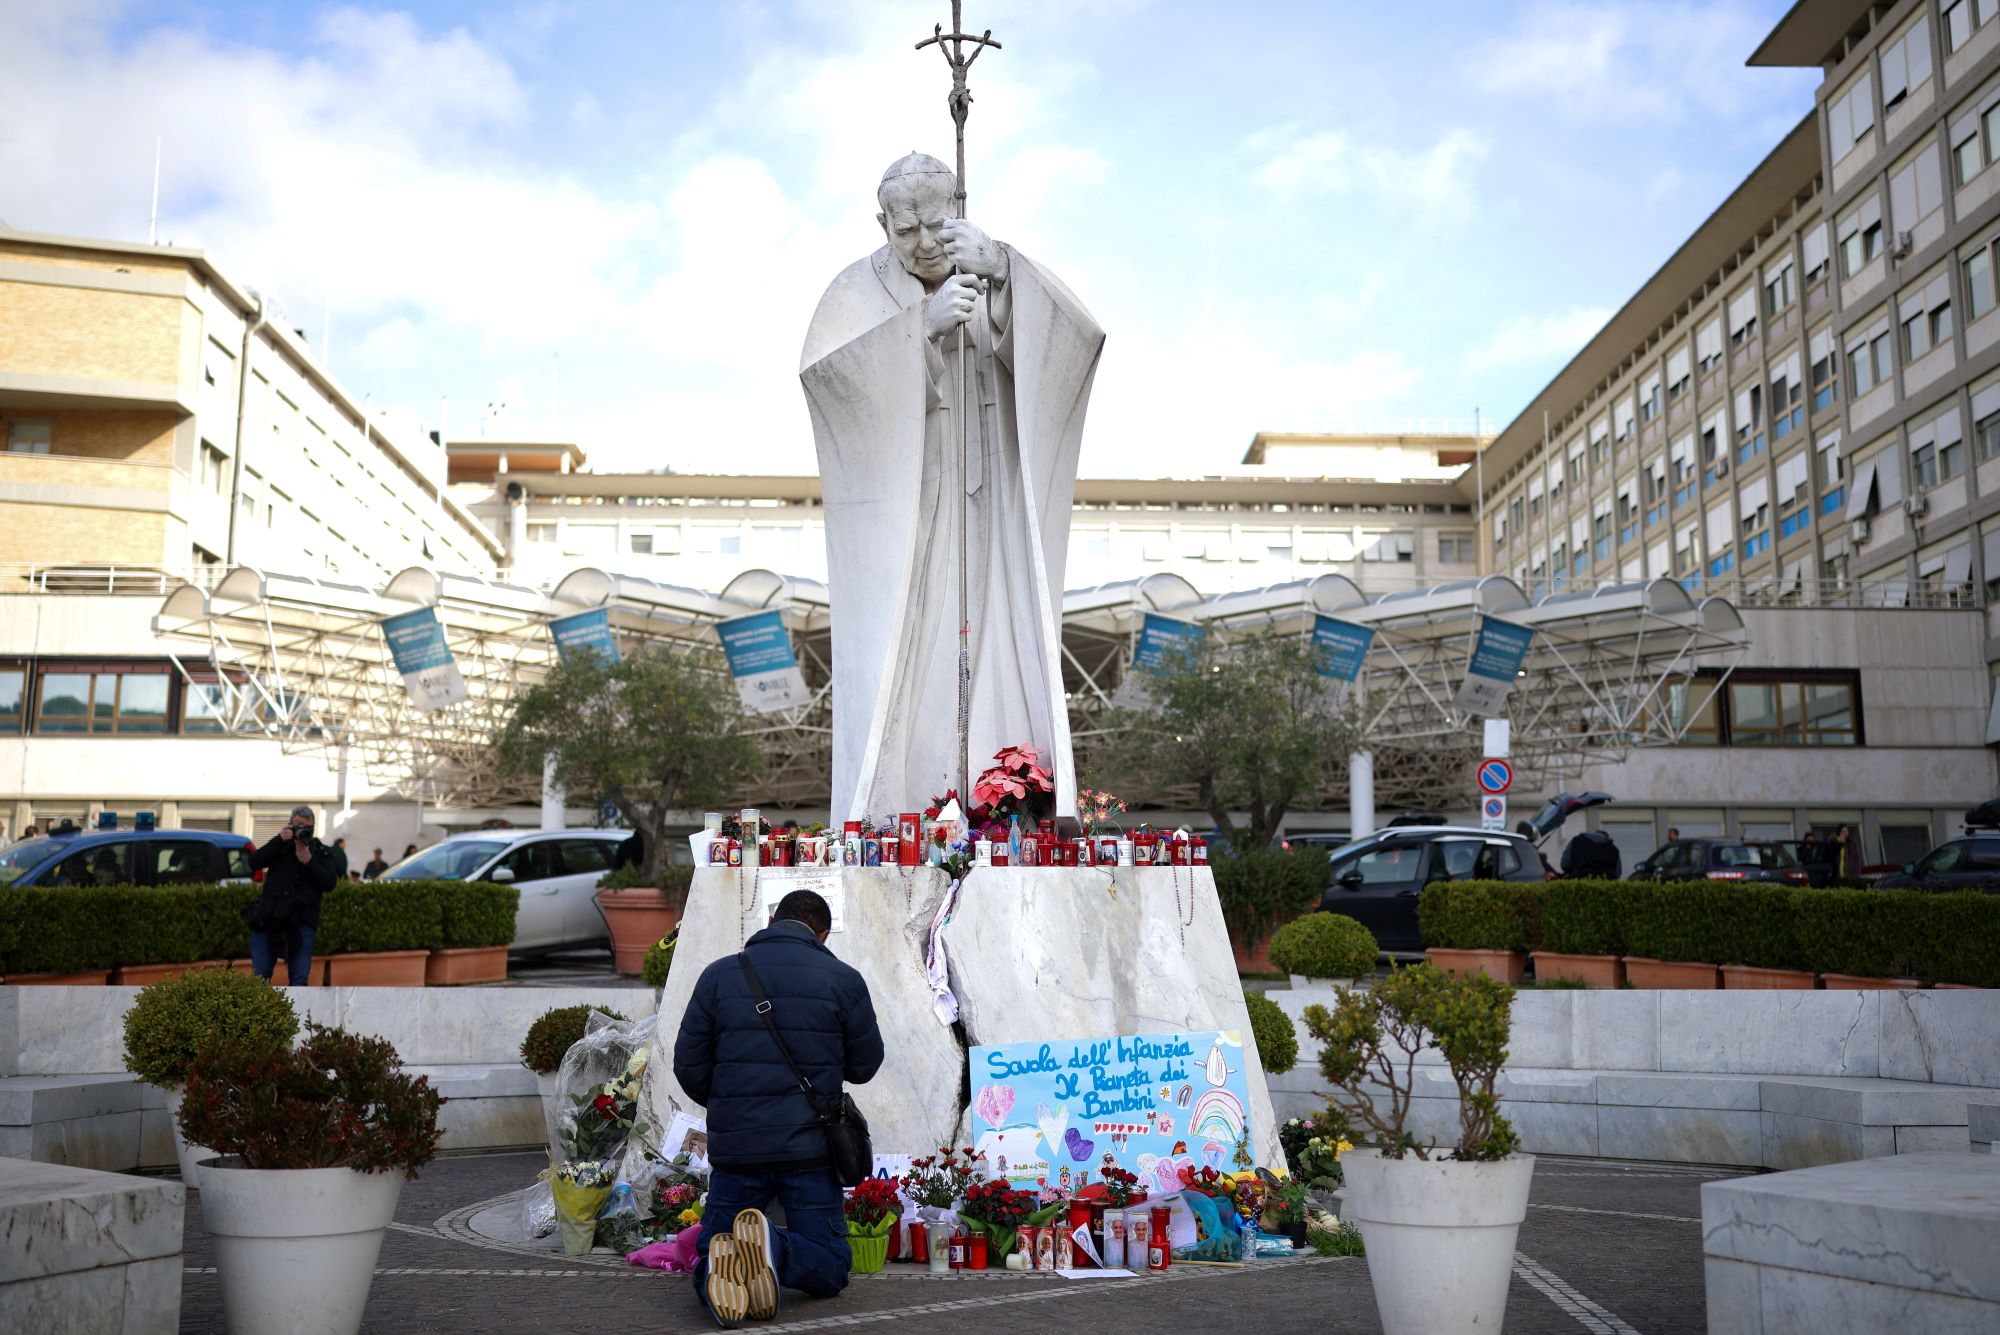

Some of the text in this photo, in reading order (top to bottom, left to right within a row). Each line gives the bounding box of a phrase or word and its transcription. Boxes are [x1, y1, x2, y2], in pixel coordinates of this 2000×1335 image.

[988, 1043, 1062, 1080] Scuola
[1054, 1060, 1190, 1100] Il Pianeta dei
[1078, 1088, 1156, 1119] Bambini
